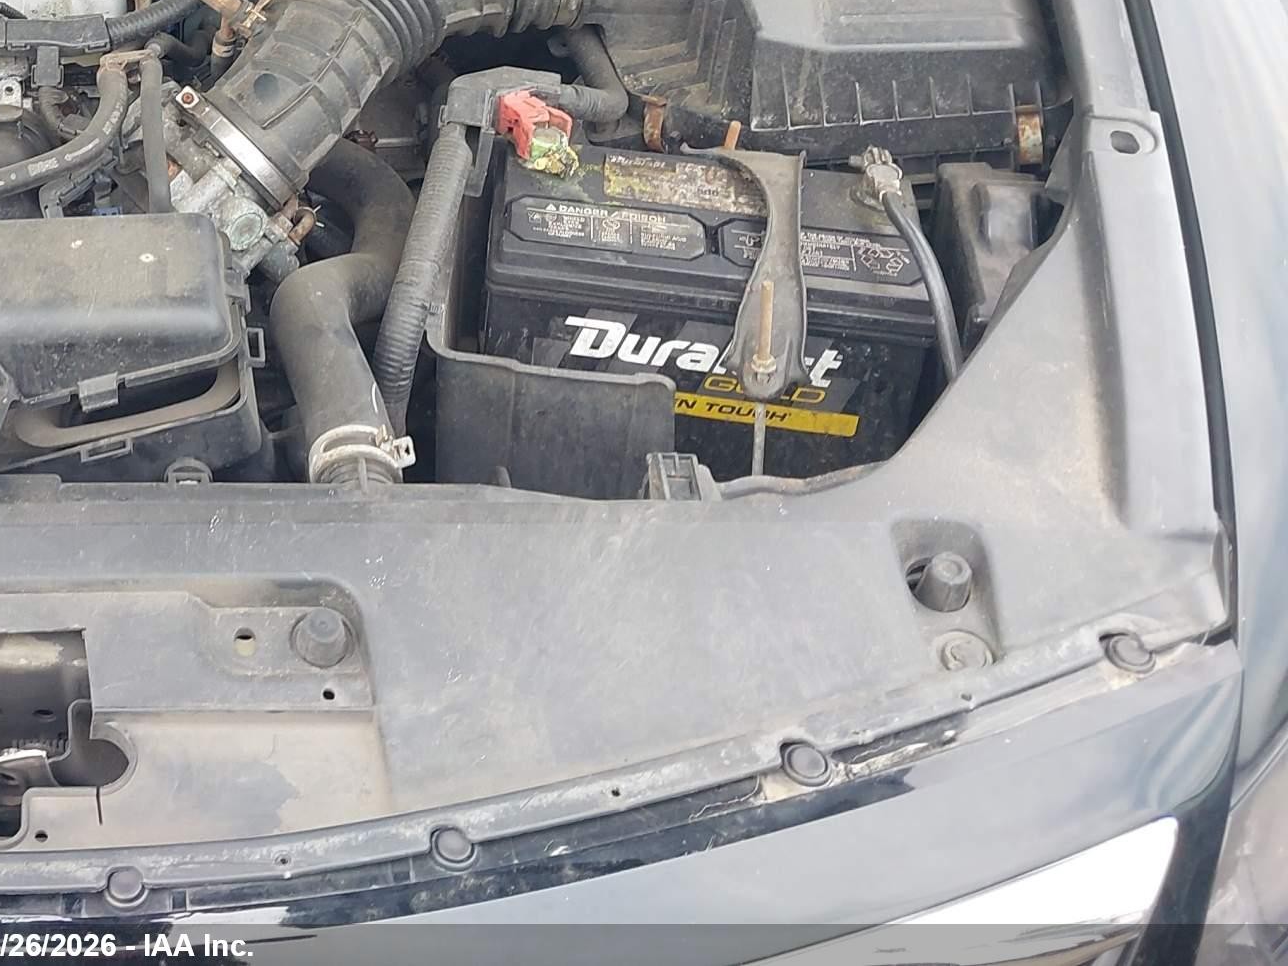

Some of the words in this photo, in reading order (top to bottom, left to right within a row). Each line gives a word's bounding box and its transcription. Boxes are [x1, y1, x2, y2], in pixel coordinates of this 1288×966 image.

[558, 204, 608, 217] DANGER
[564, 315, 843, 388] Durat
[704, 375, 826, 404] GD
[705, 402, 788, 422] TOUH
